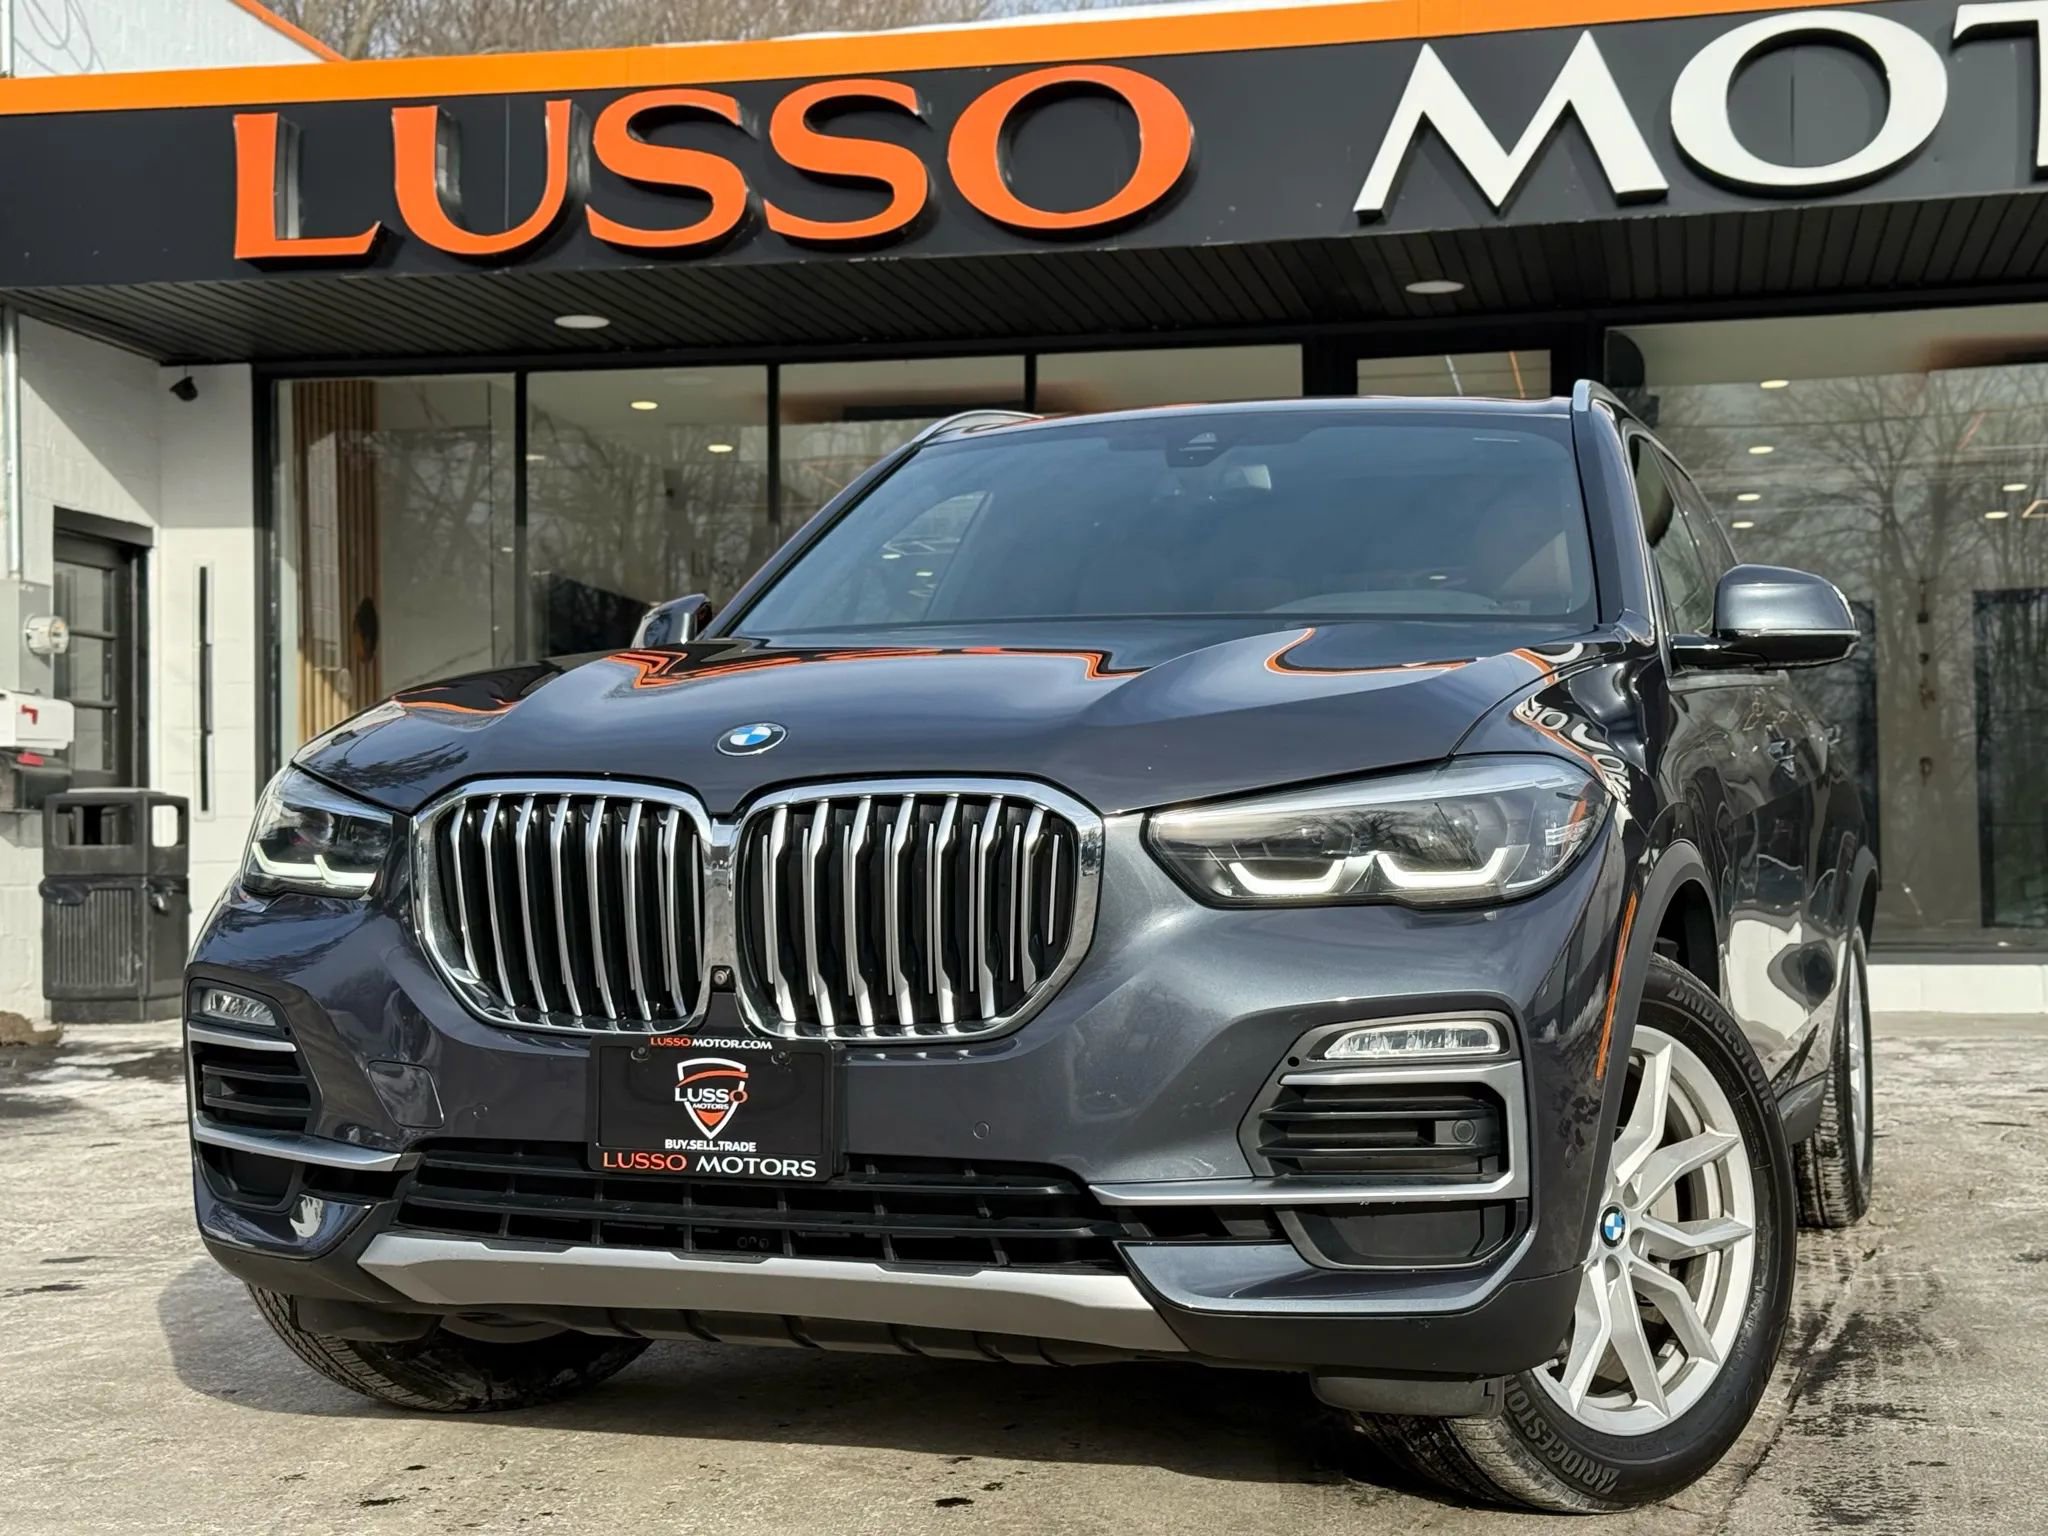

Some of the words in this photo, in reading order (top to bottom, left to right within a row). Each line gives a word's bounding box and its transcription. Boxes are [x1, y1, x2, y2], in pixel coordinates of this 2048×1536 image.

[233, 64, 1193, 259] LUSSO
[650, 1036, 773, 1050] LUSSOMOTOR.COM
[674, 1087, 748, 1103] LUSSO
[692, 1102, 729, 1110] MOTORS
[603, 1151, 688, 1172] LUSSO
[695, 1155, 817, 1178] MOTORS
